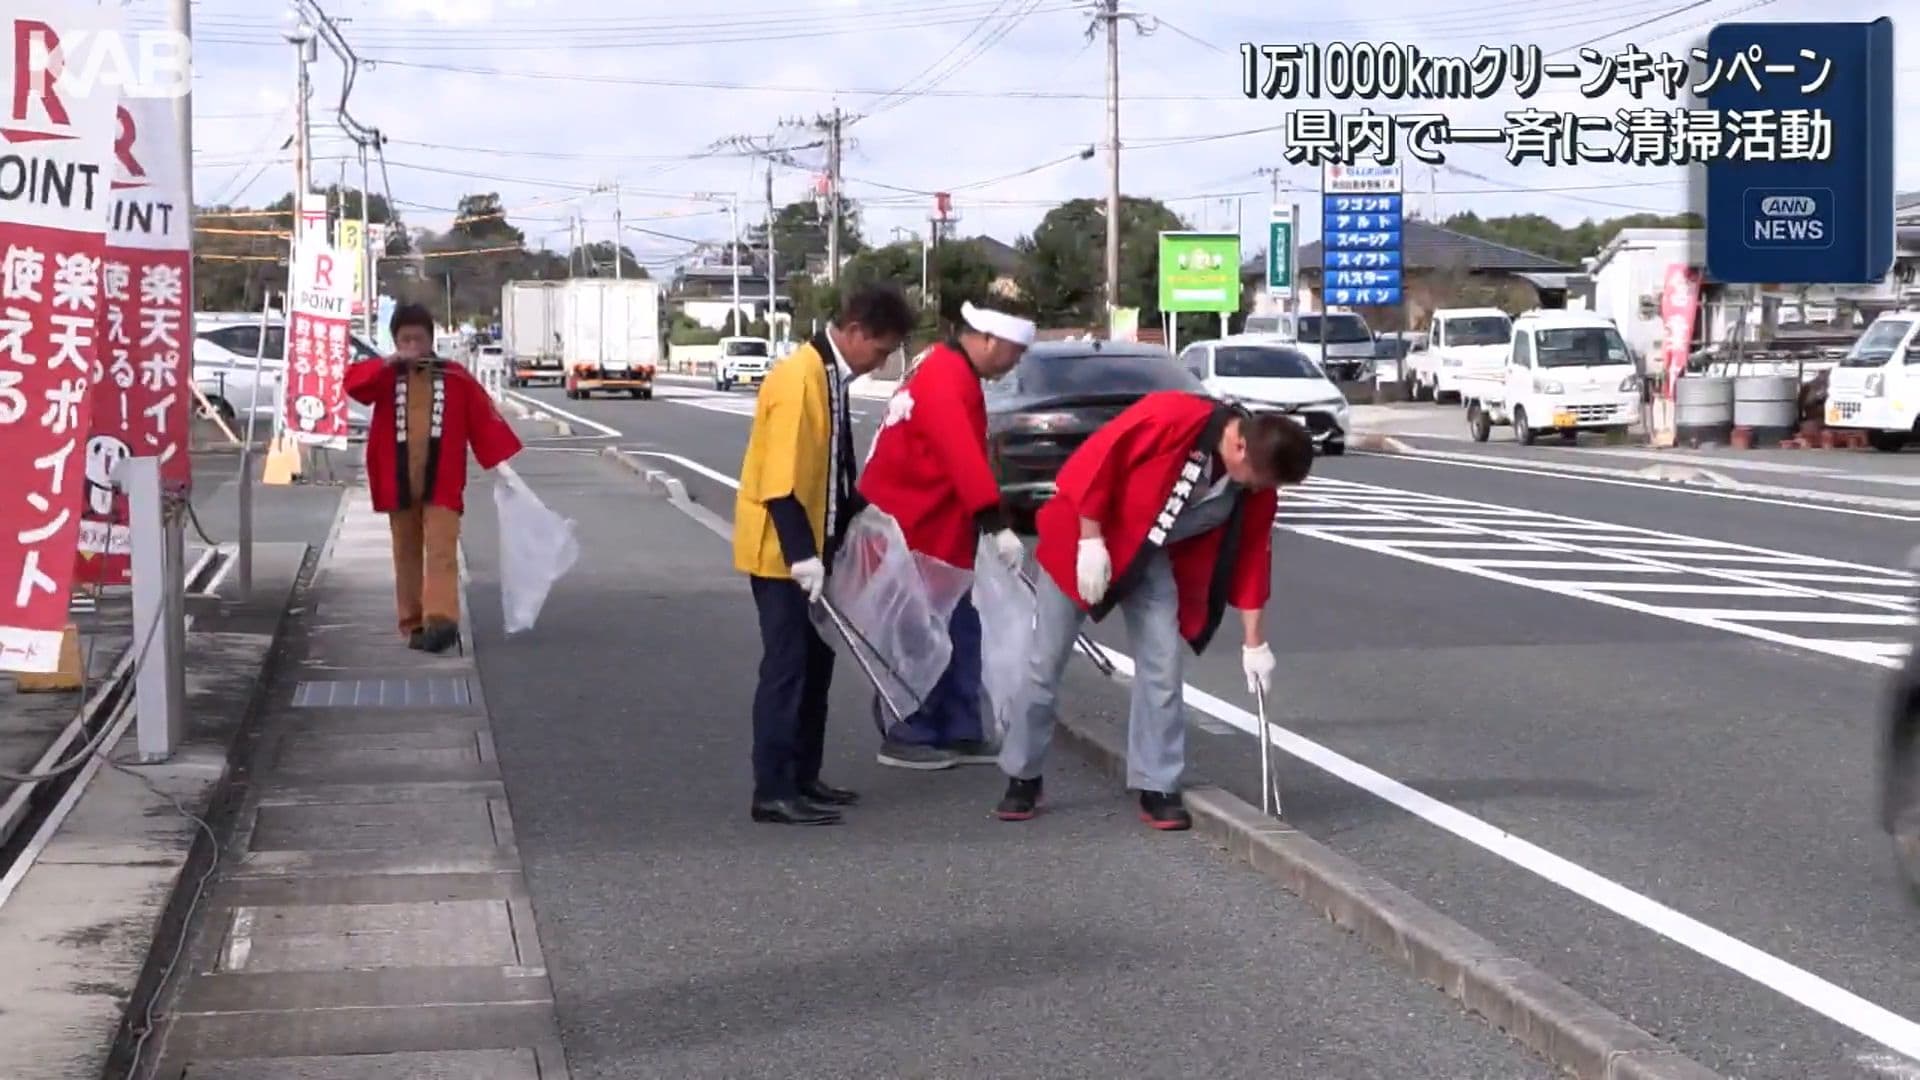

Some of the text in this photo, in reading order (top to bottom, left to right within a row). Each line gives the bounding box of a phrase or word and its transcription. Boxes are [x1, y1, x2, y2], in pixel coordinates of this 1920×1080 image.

[0, 155, 99, 210] OINT
[106, 201, 173, 234] INT
[314, 254, 334, 287] R
[1336, 251, 1391, 266] スイフト
[1337, 271, 1390, 286] ハスラー
[301, 291, 344, 312] POINT
[139, 263, 183, 464] 楽天ポイン
[15, 252, 101, 608] 楽天ポイント
